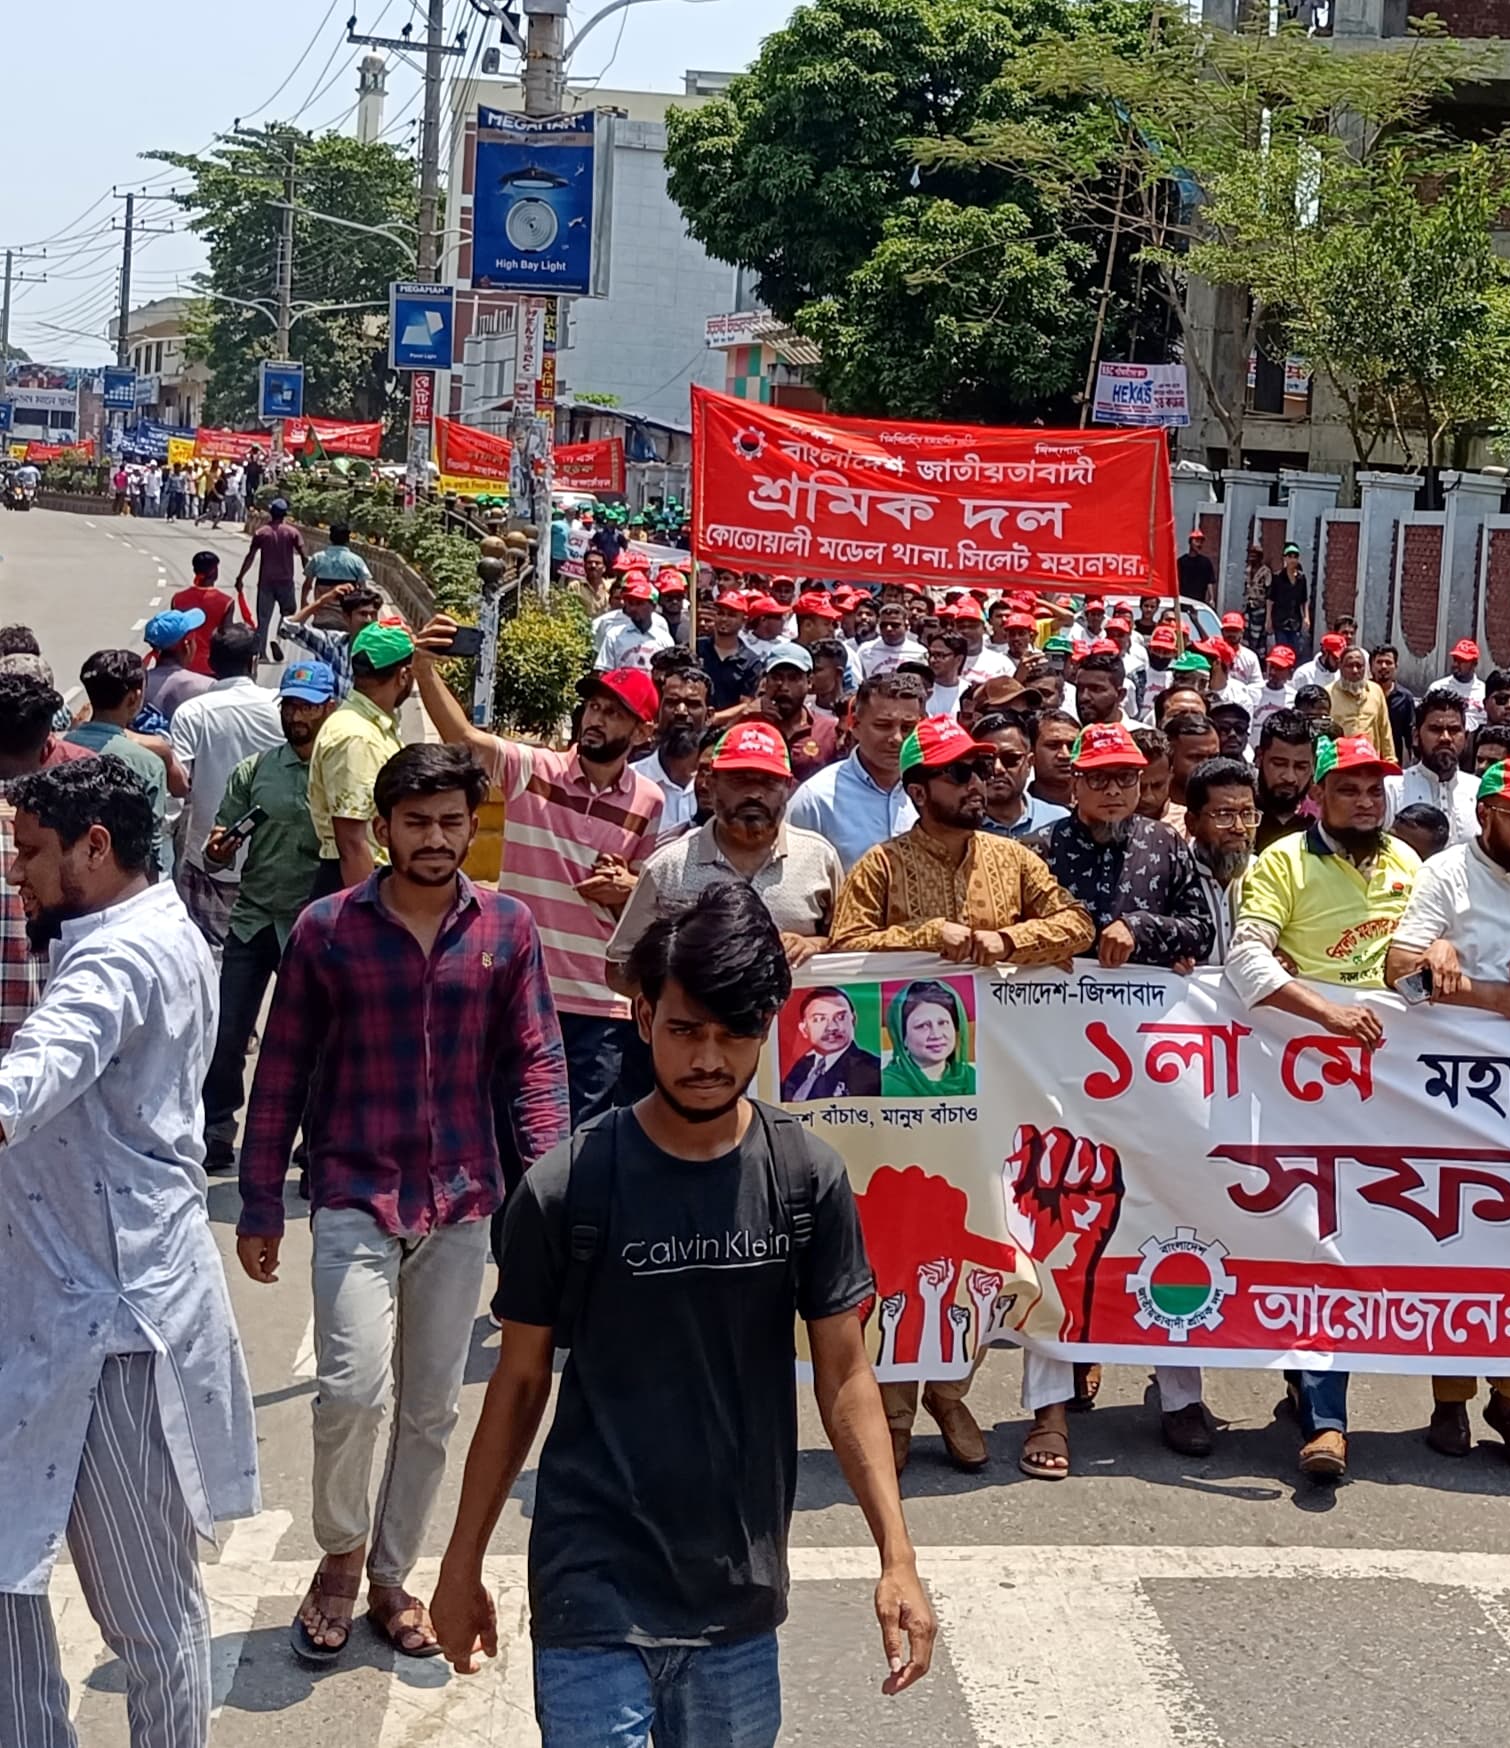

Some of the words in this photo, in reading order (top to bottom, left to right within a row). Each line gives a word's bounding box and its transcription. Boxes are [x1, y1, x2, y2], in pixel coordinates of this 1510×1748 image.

[496, 259, 518, 271] High
[521, 260, 538, 272] Bay
[541, 260, 566, 272] Light
[778, 439, 906, 476] বাংলাদেশ
[916, 453, 1096, 485] জাতীয়তাবাদী
[749, 469, 941, 530] শ্রমিক
[958, 498, 1072, 539] দল
[706, 523, 812, 558] কোতোয়ালী
[817, 536, 887, 565] মডেল
[958, 539, 1031, 573] সিলেট
[990, 975, 1166, 1008] বাংলাদেশ-জিন্দাবাদ
[1082, 1020, 1253, 1100] ১লা
[1280, 1033, 1385, 1103] মে
[820, 1103, 874, 1128] বাঁচাও,
[881, 1108, 924, 1130] মানুষ
[929, 1102, 979, 1126] বাঁচাও
[621, 1233, 719, 1267] Calvin
[725, 1230, 790, 1259] Klein
